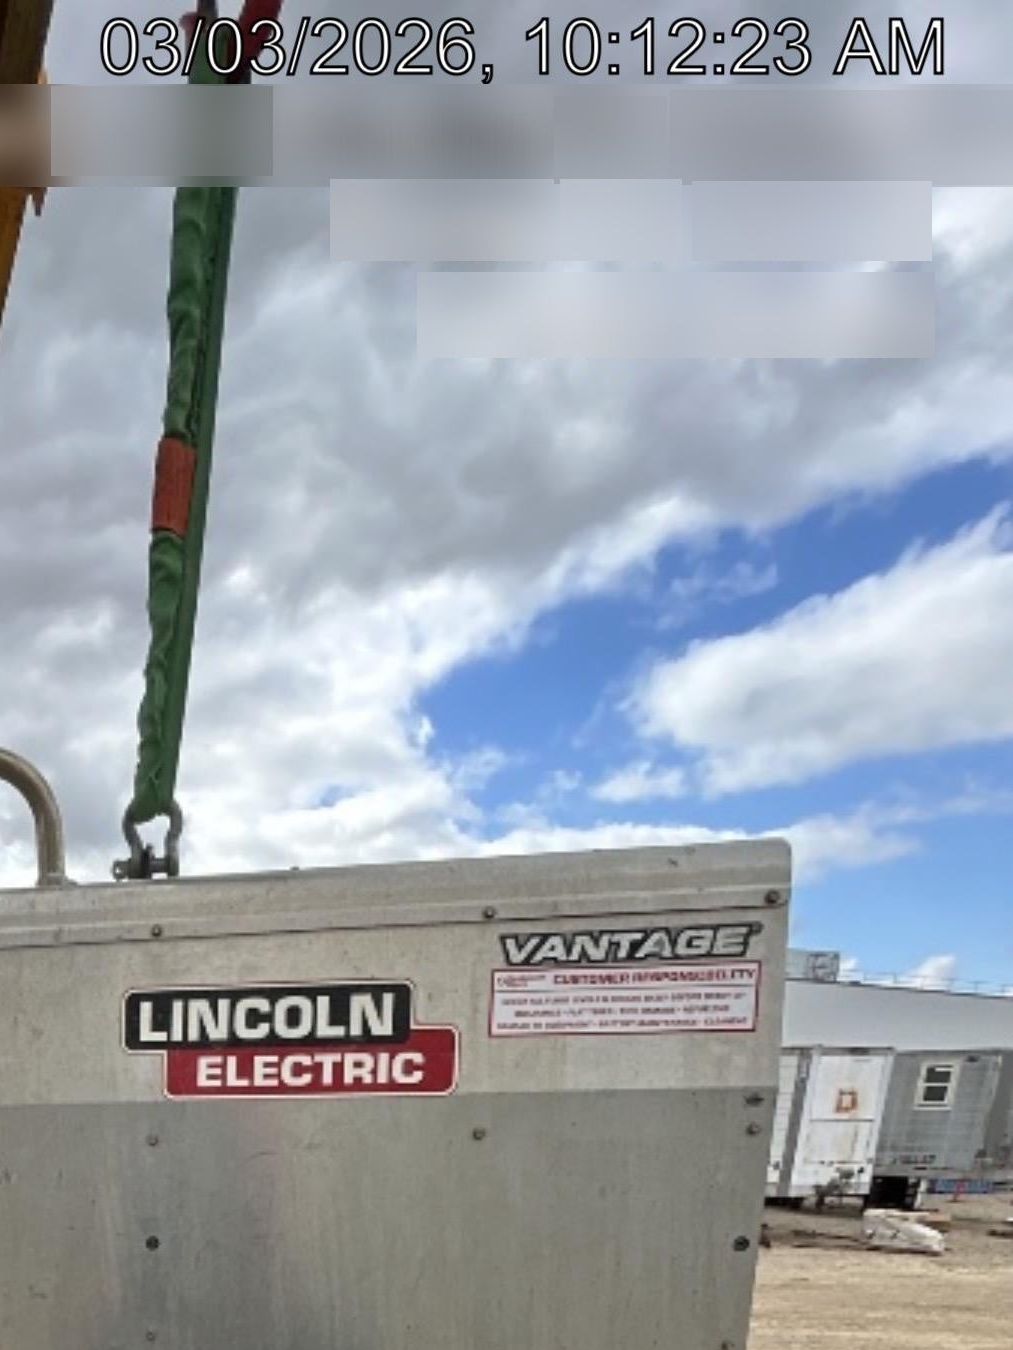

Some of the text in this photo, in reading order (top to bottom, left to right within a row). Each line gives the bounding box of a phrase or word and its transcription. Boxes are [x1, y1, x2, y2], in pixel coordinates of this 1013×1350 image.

[502, 925, 752, 964] VANTAGE
[138, 993, 395, 1042] LINCOLN
[196, 1052, 426, 1088] ELECTRIC
